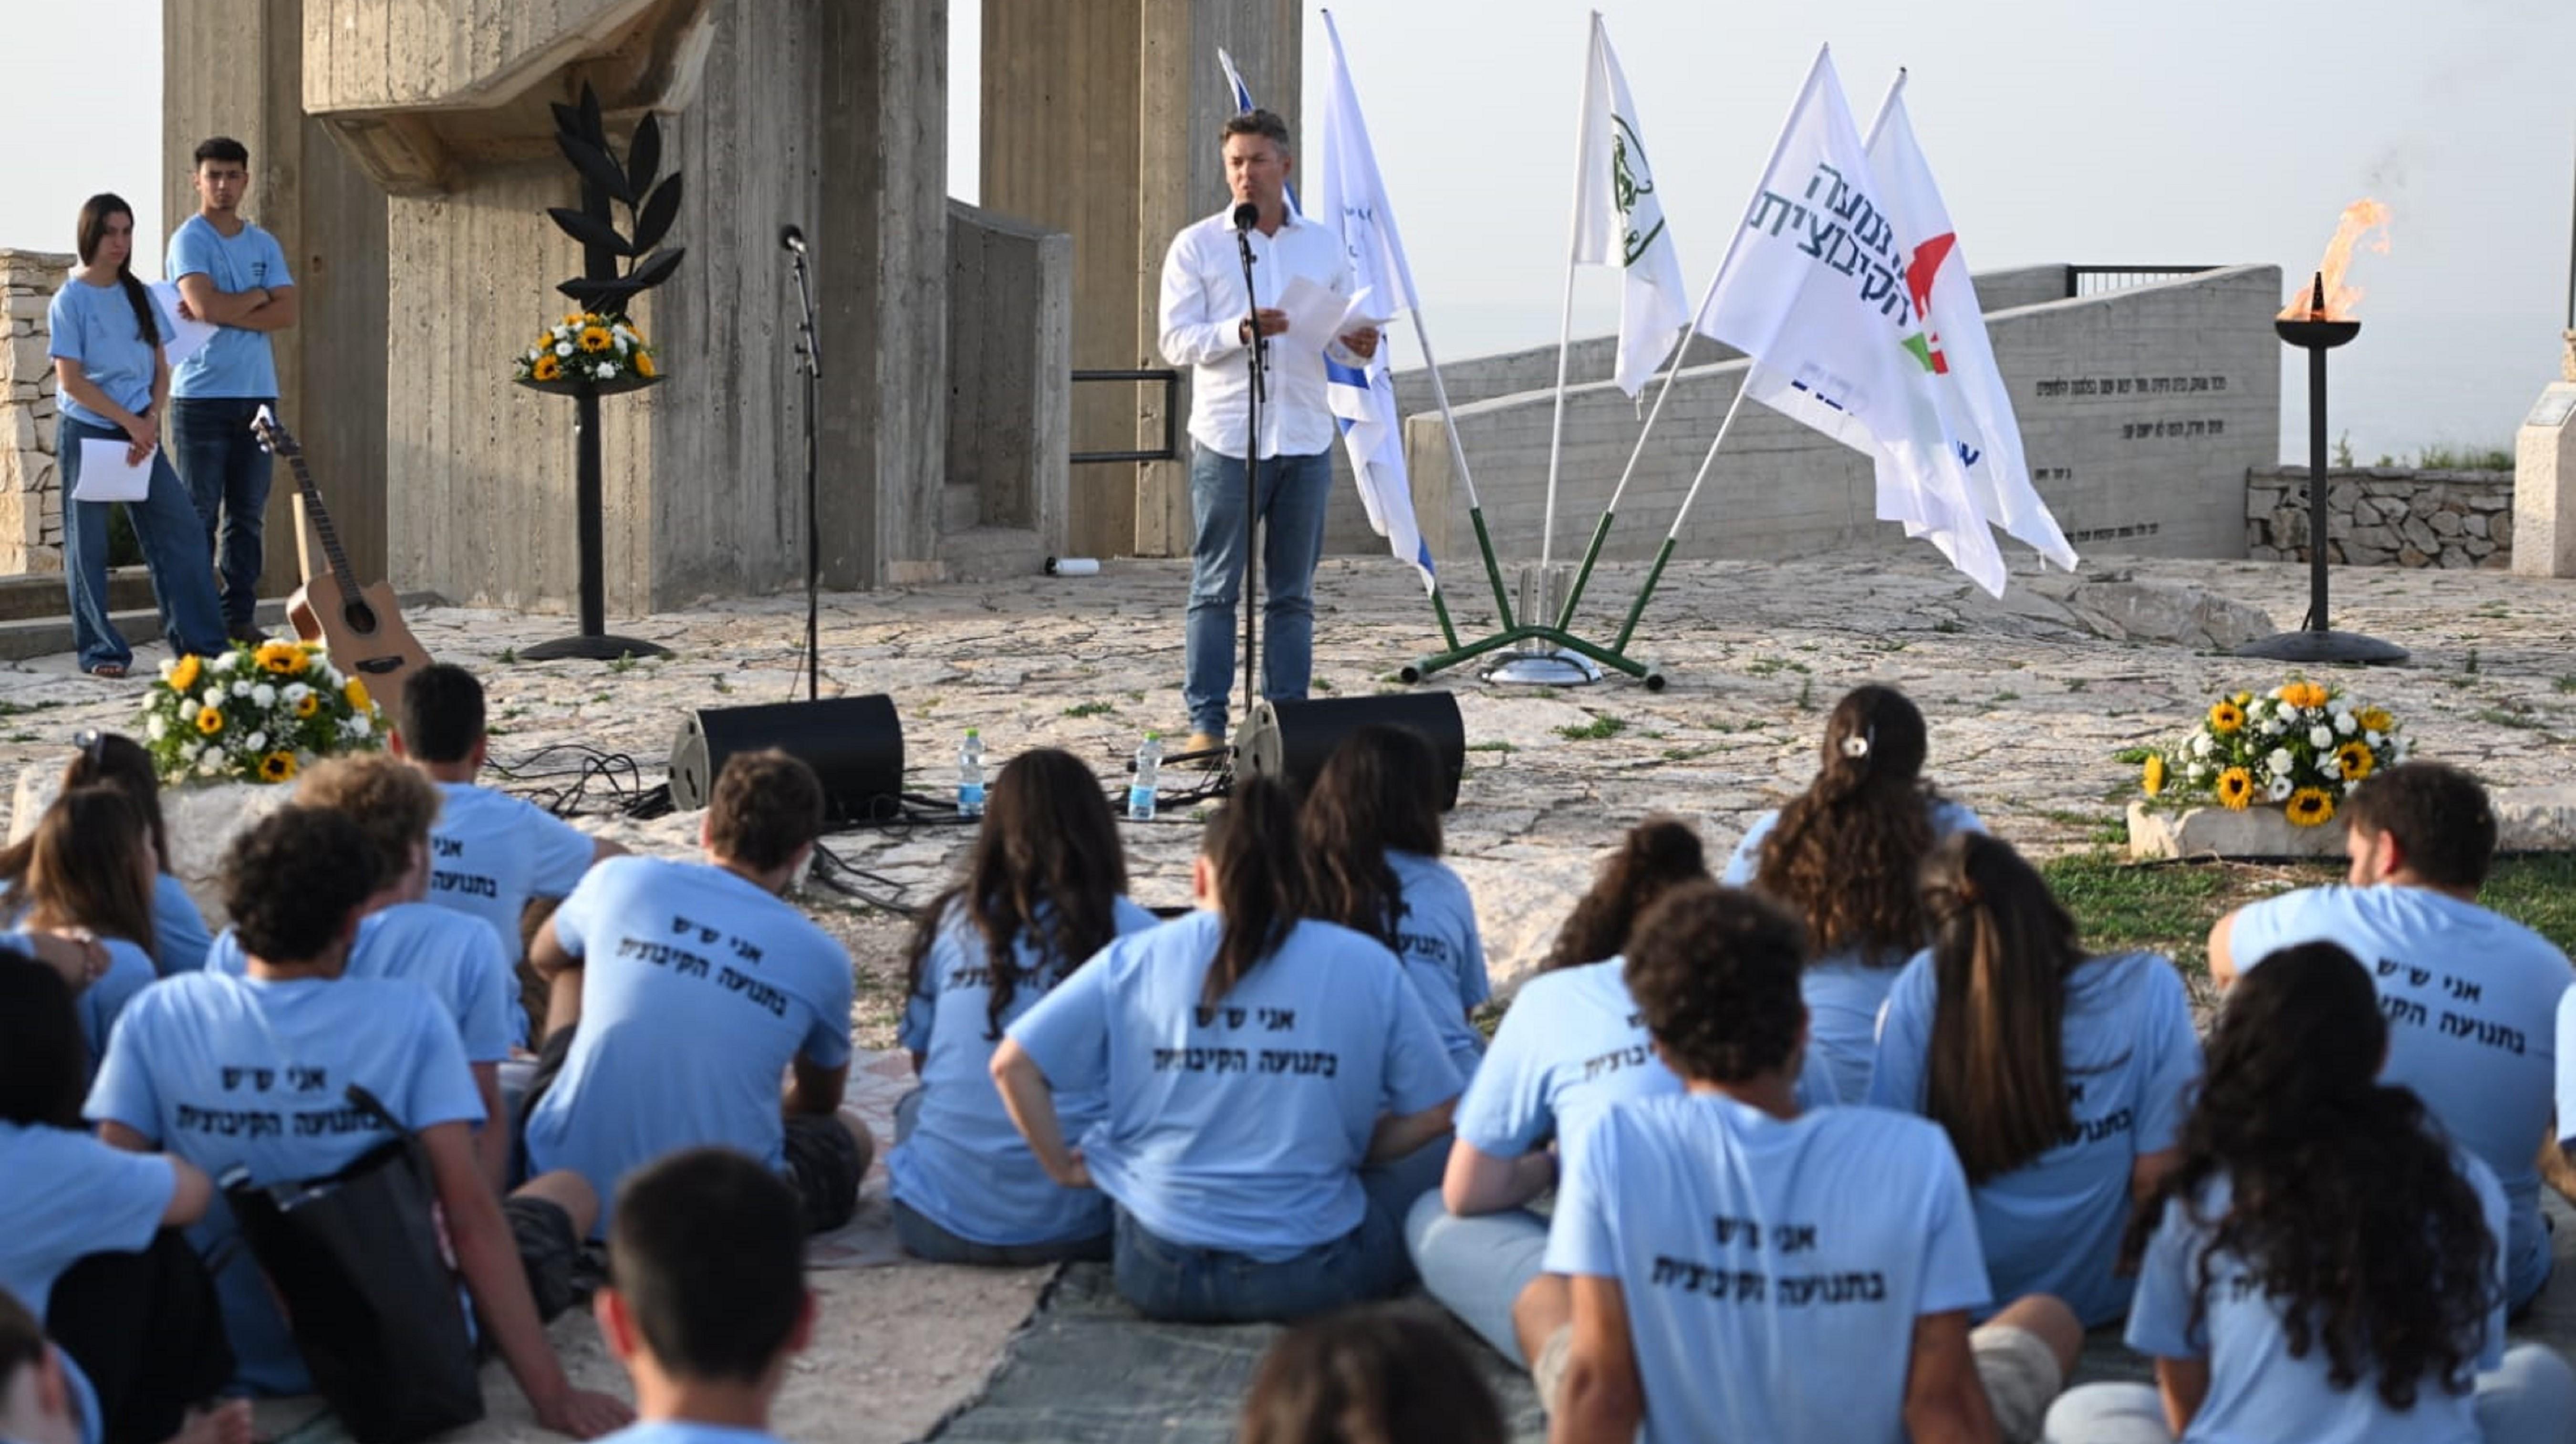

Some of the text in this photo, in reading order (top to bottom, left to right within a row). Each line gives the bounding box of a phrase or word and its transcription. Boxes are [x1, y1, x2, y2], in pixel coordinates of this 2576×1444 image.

[1750, 190, 1910, 327] הקיבוצית
[729, 936, 763, 966] אני
[717, 966, 788, 1018] בתנועה
[2442, 974, 2482, 1003] אני
[1257, 1008, 1295, 1031] אני
[2439, 1011, 2526, 1055] בתנועה
[287, 1066, 326, 1091] אני
[1258, 1049, 1337, 1078] בתנועה
[1777, 1272, 1885, 1306] בתנועה
